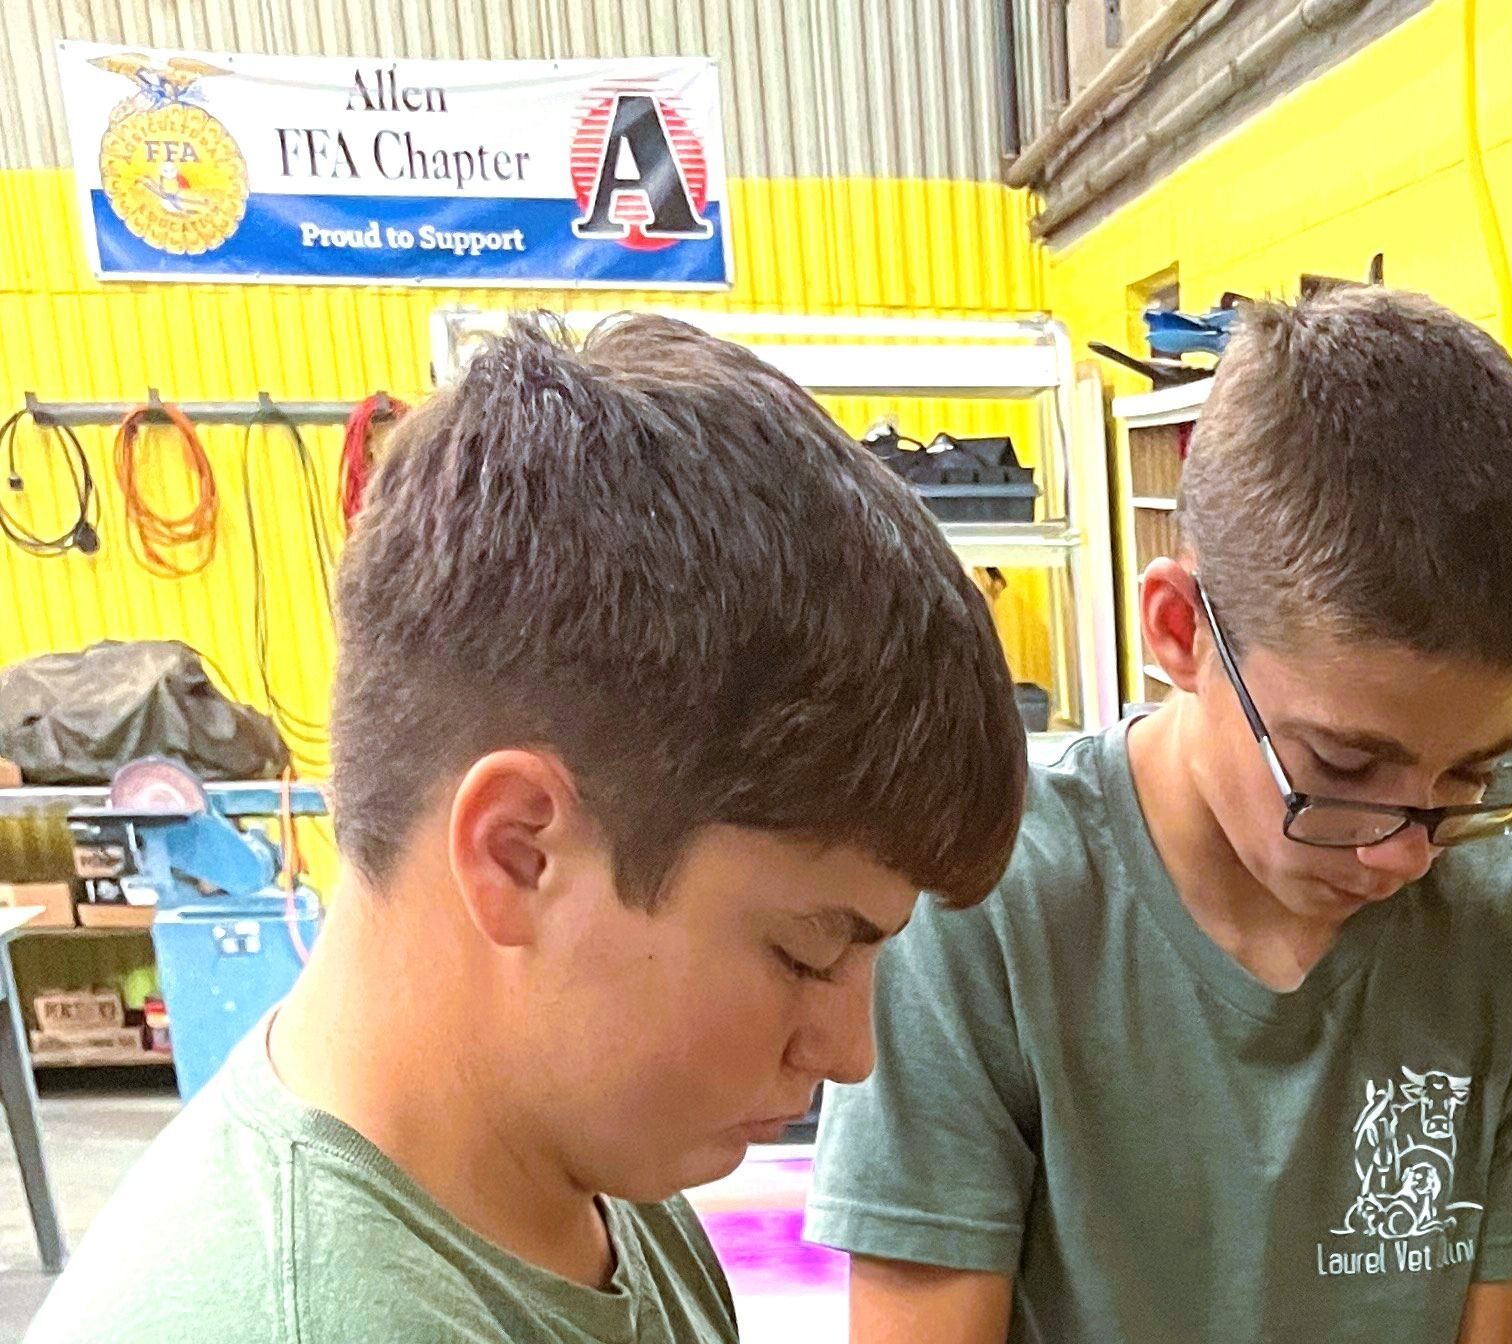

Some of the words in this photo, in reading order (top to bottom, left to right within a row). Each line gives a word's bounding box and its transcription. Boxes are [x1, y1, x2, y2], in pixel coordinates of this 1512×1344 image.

[345, 65, 448, 114] Allen
[144, 140, 201, 163] FFA
[273, 128, 361, 180] FFA
[373, 130, 531, 190] Chapter
[576, 91, 714, 240] A
[301, 221, 382, 250] Proud
[386, 223, 415, 250] to
[419, 225, 526, 256] Support
[1317, 1242, 1387, 1276] Laurel
[1394, 1240, 1432, 1272] Vet
